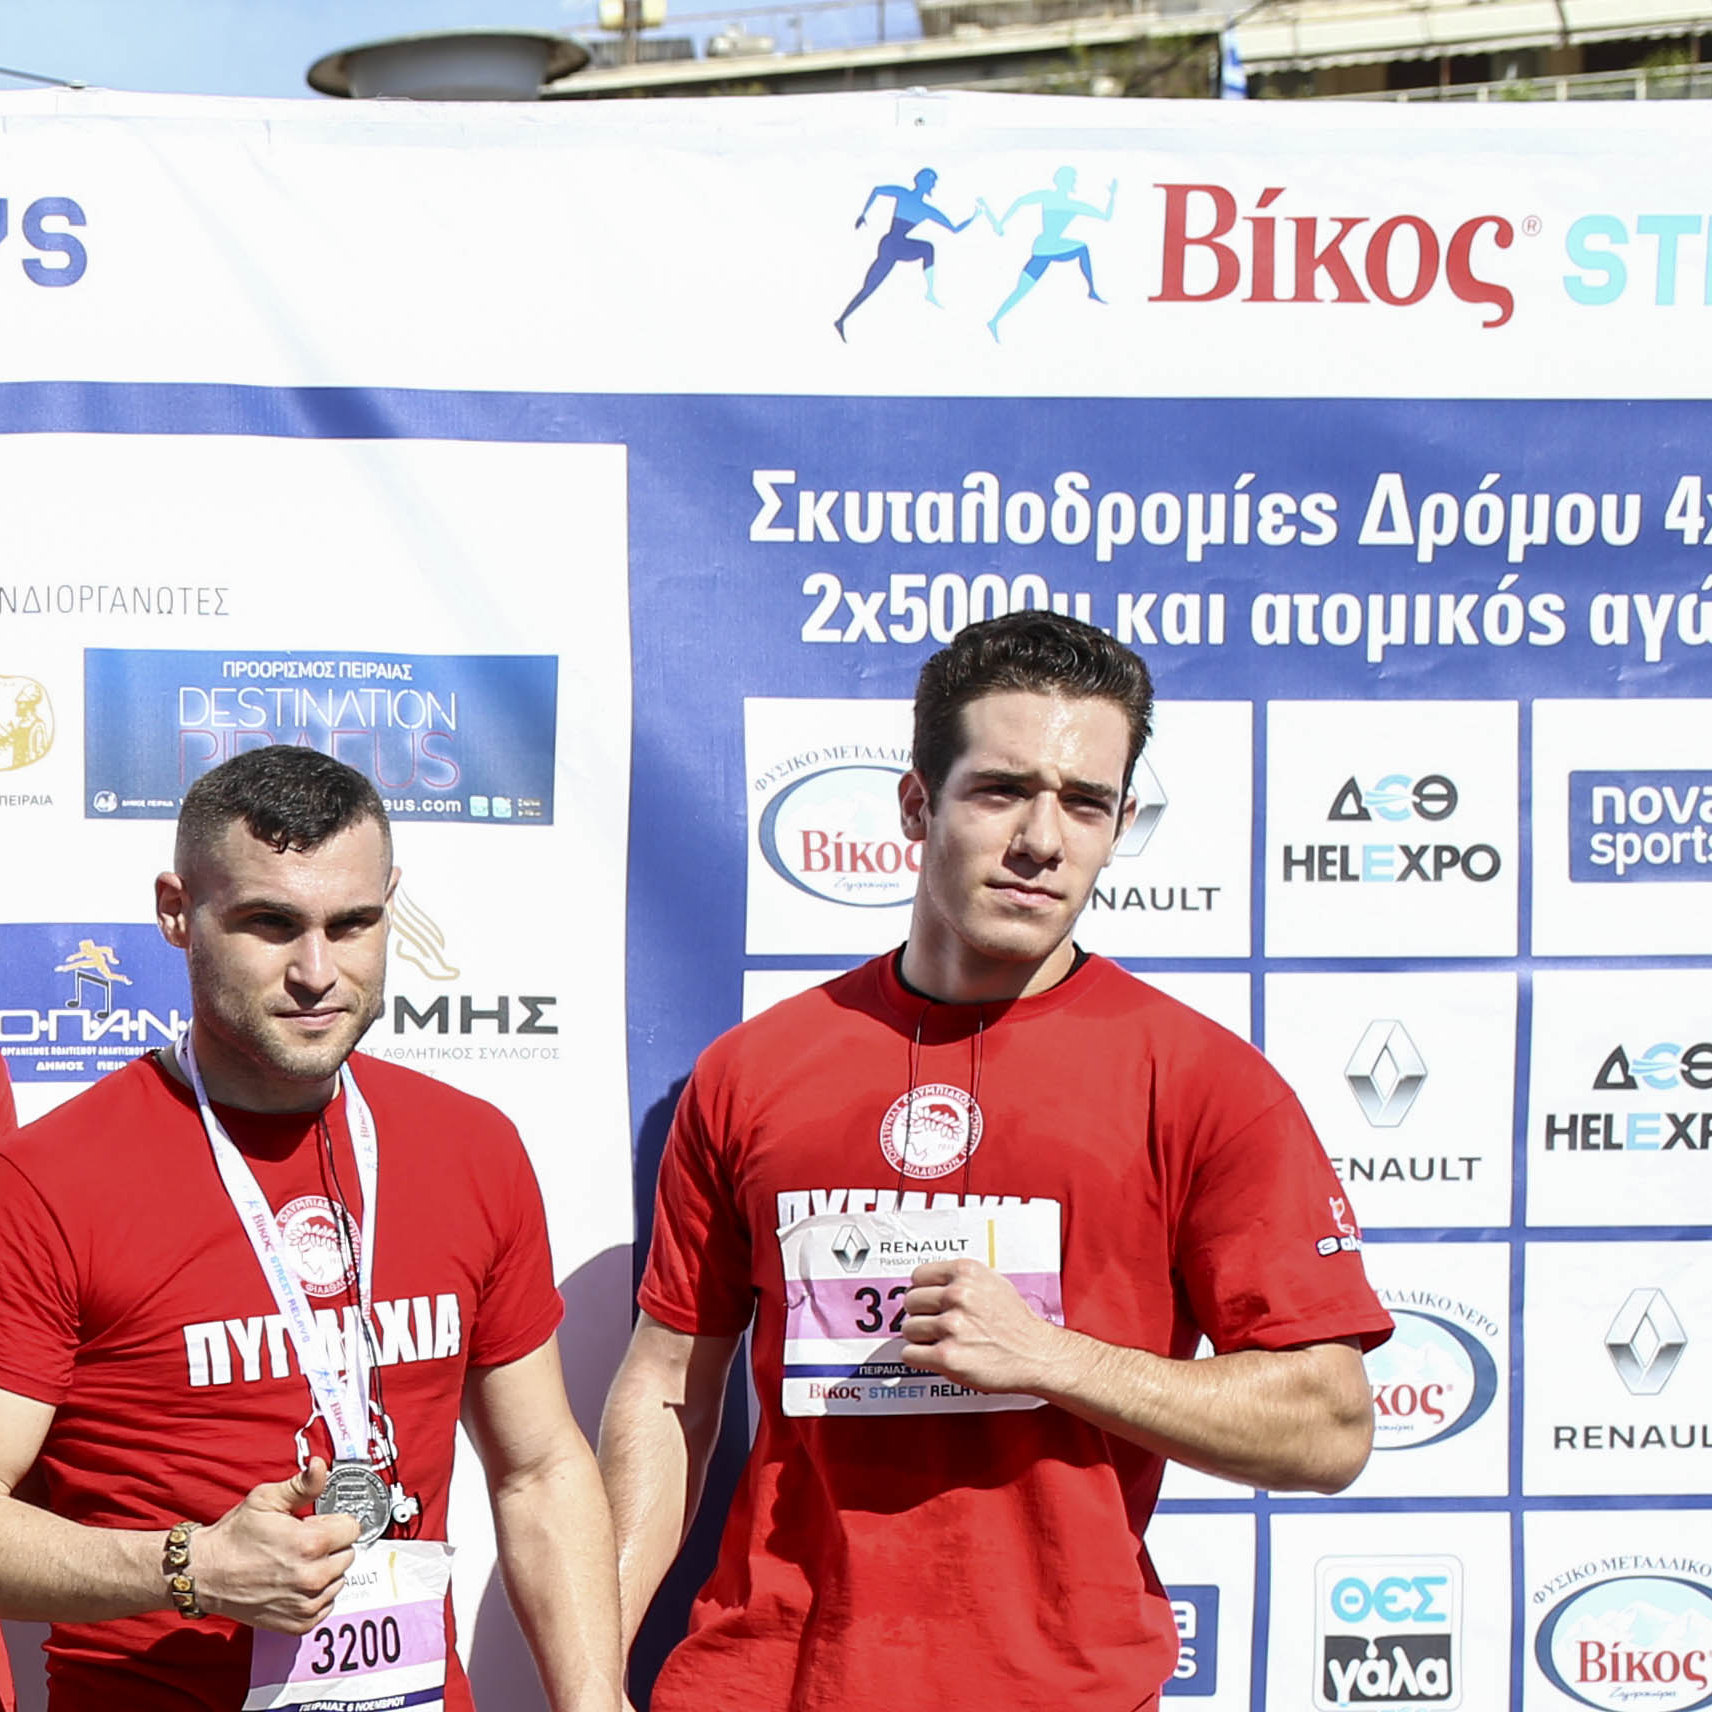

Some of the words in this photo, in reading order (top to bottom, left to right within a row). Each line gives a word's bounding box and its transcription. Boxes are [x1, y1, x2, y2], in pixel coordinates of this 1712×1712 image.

[1147, 182, 1516, 330] Βίκος
[1562, 213, 1712, 307] ST
[748, 467, 1338, 562] Σκυταλοδρομίες
[1358, 470, 1640, 563] Δρόμου
[1662, 473, 1712, 544] 4
[1251, 573, 1565, 656] ατομικός
[222, 661, 336, 680] ΠΡΟΟΡΙΣΜΟΣ
[338, 662, 413, 682] ΠΕΙΡΑΙΑΣ
[178, 686, 457, 732] DESTINATION
[1282, 842, 1502, 883] HELEXPO
[382, 1047, 474, 1060] ΑΘΛΗΤΙΚΟΣ
[478, 1047, 560, 1061] ΣΥΛΛΟΓΟΣ
[879, 1238, 970, 1254] RENAULT
[1452, 1301, 1500, 1338] ΝΕΡΟ
[808, 1382, 862, 1402] Βίκος
[868, 1385, 927, 1399] STREET
[859, 1365, 907, 1376] ΠΕΙΡΑΙΑΣ
[1330, 1574, 1449, 1623] ΘΕΣ
[310, 1615, 401, 1675] 3200
[1575, 1638, 1709, 1689] Βίκος
[1328, 1649, 1451, 1708] γάλα
